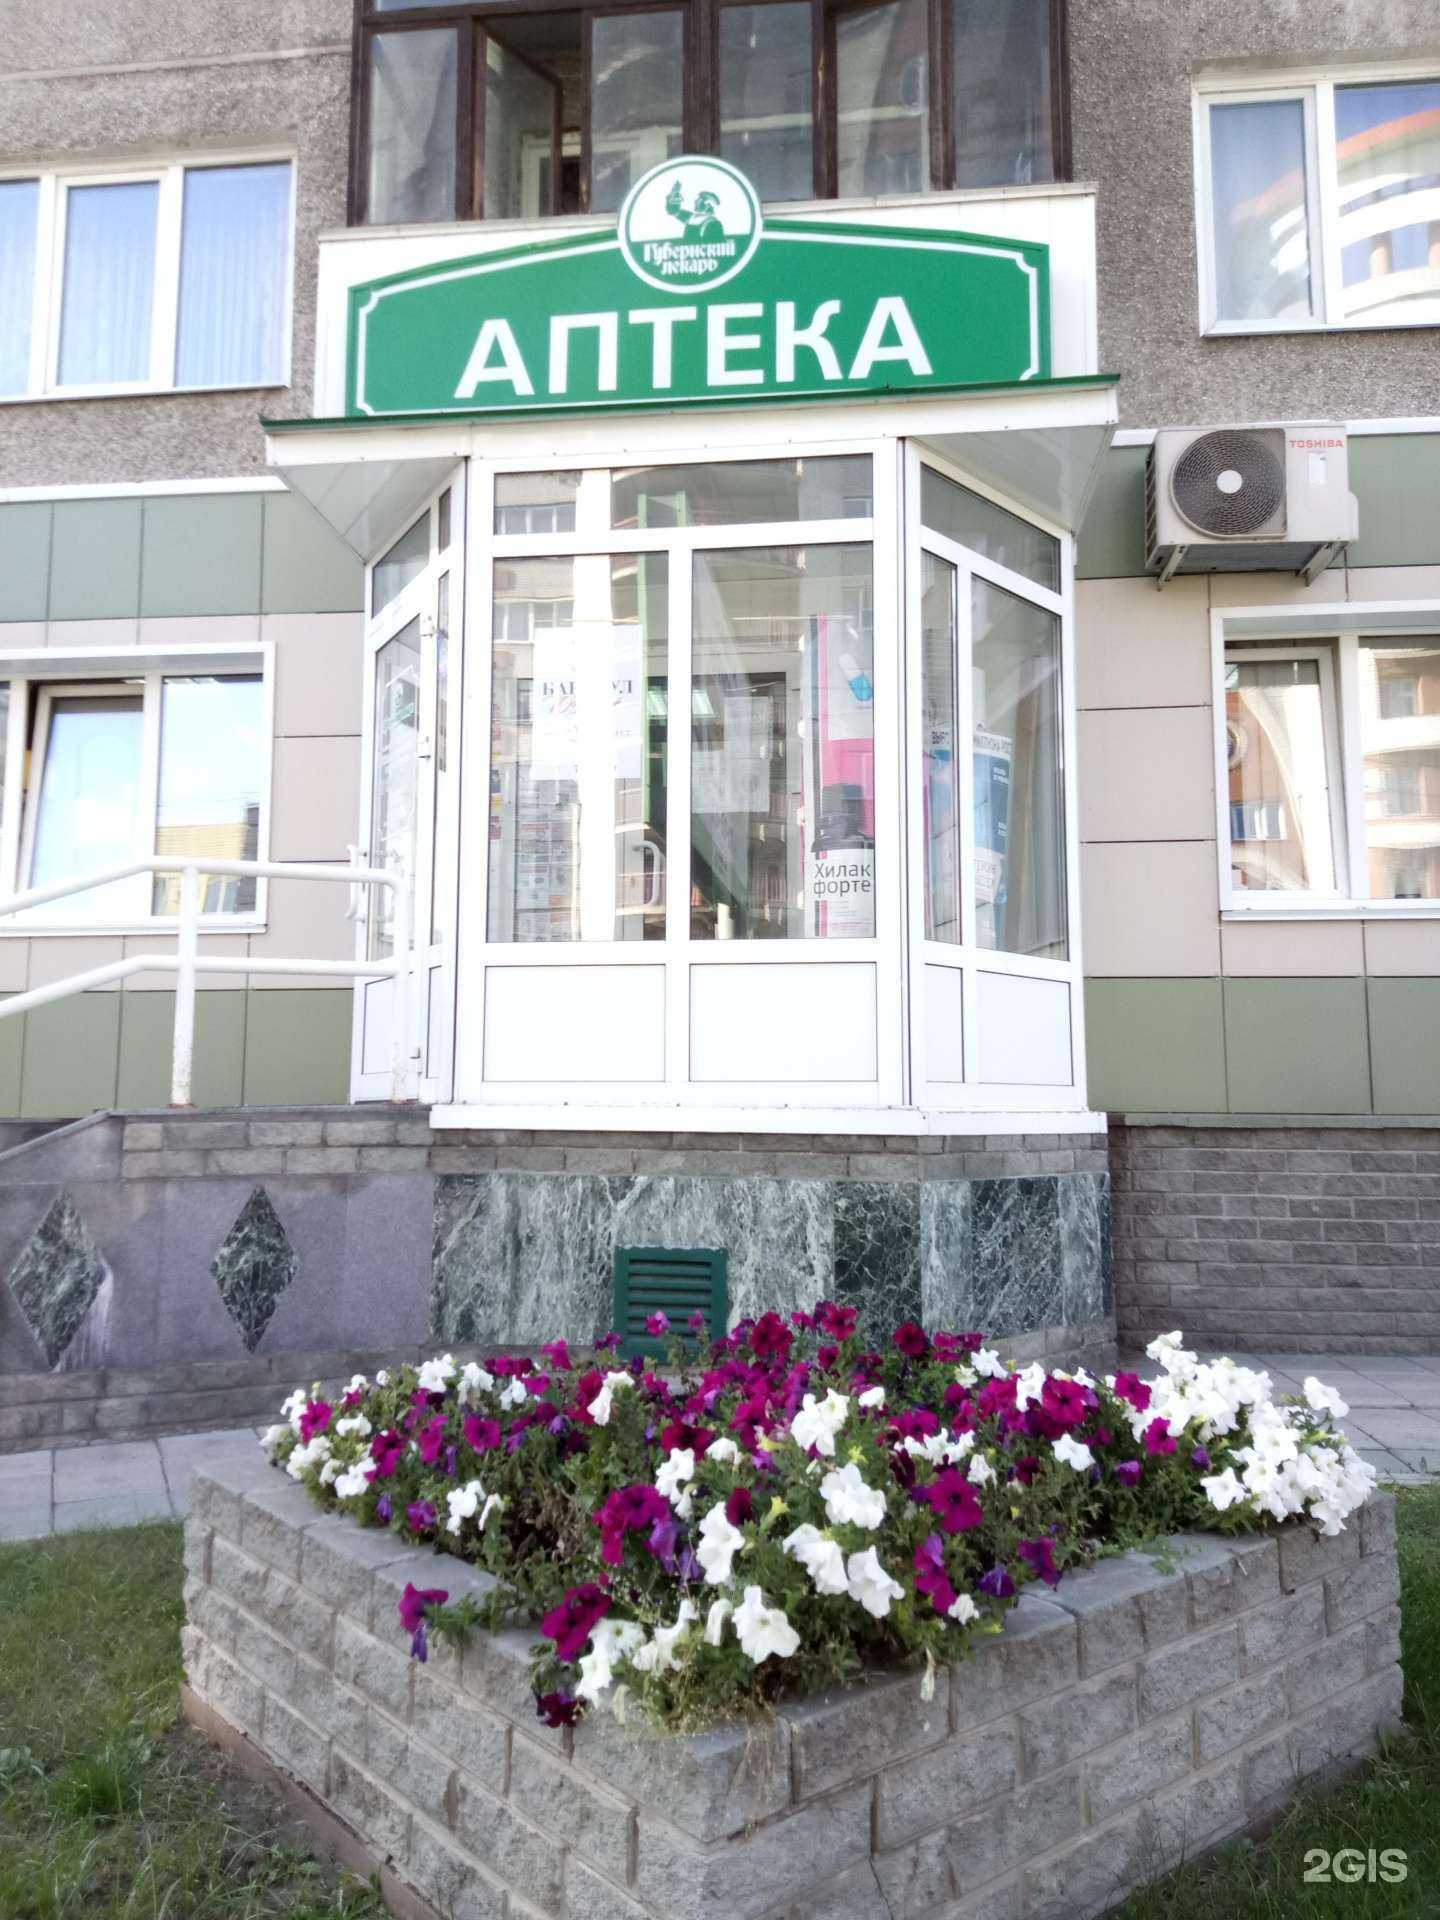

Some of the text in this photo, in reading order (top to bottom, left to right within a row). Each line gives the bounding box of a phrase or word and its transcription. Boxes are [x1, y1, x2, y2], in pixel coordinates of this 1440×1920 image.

[644, 240, 735, 266] Губернский
[454, 296, 933, 398] АПТЕКА
[1289, 439, 1344, 449] TOSHIBA
[815, 863, 871, 878] Хилак
[814, 880, 871, 897] форте
